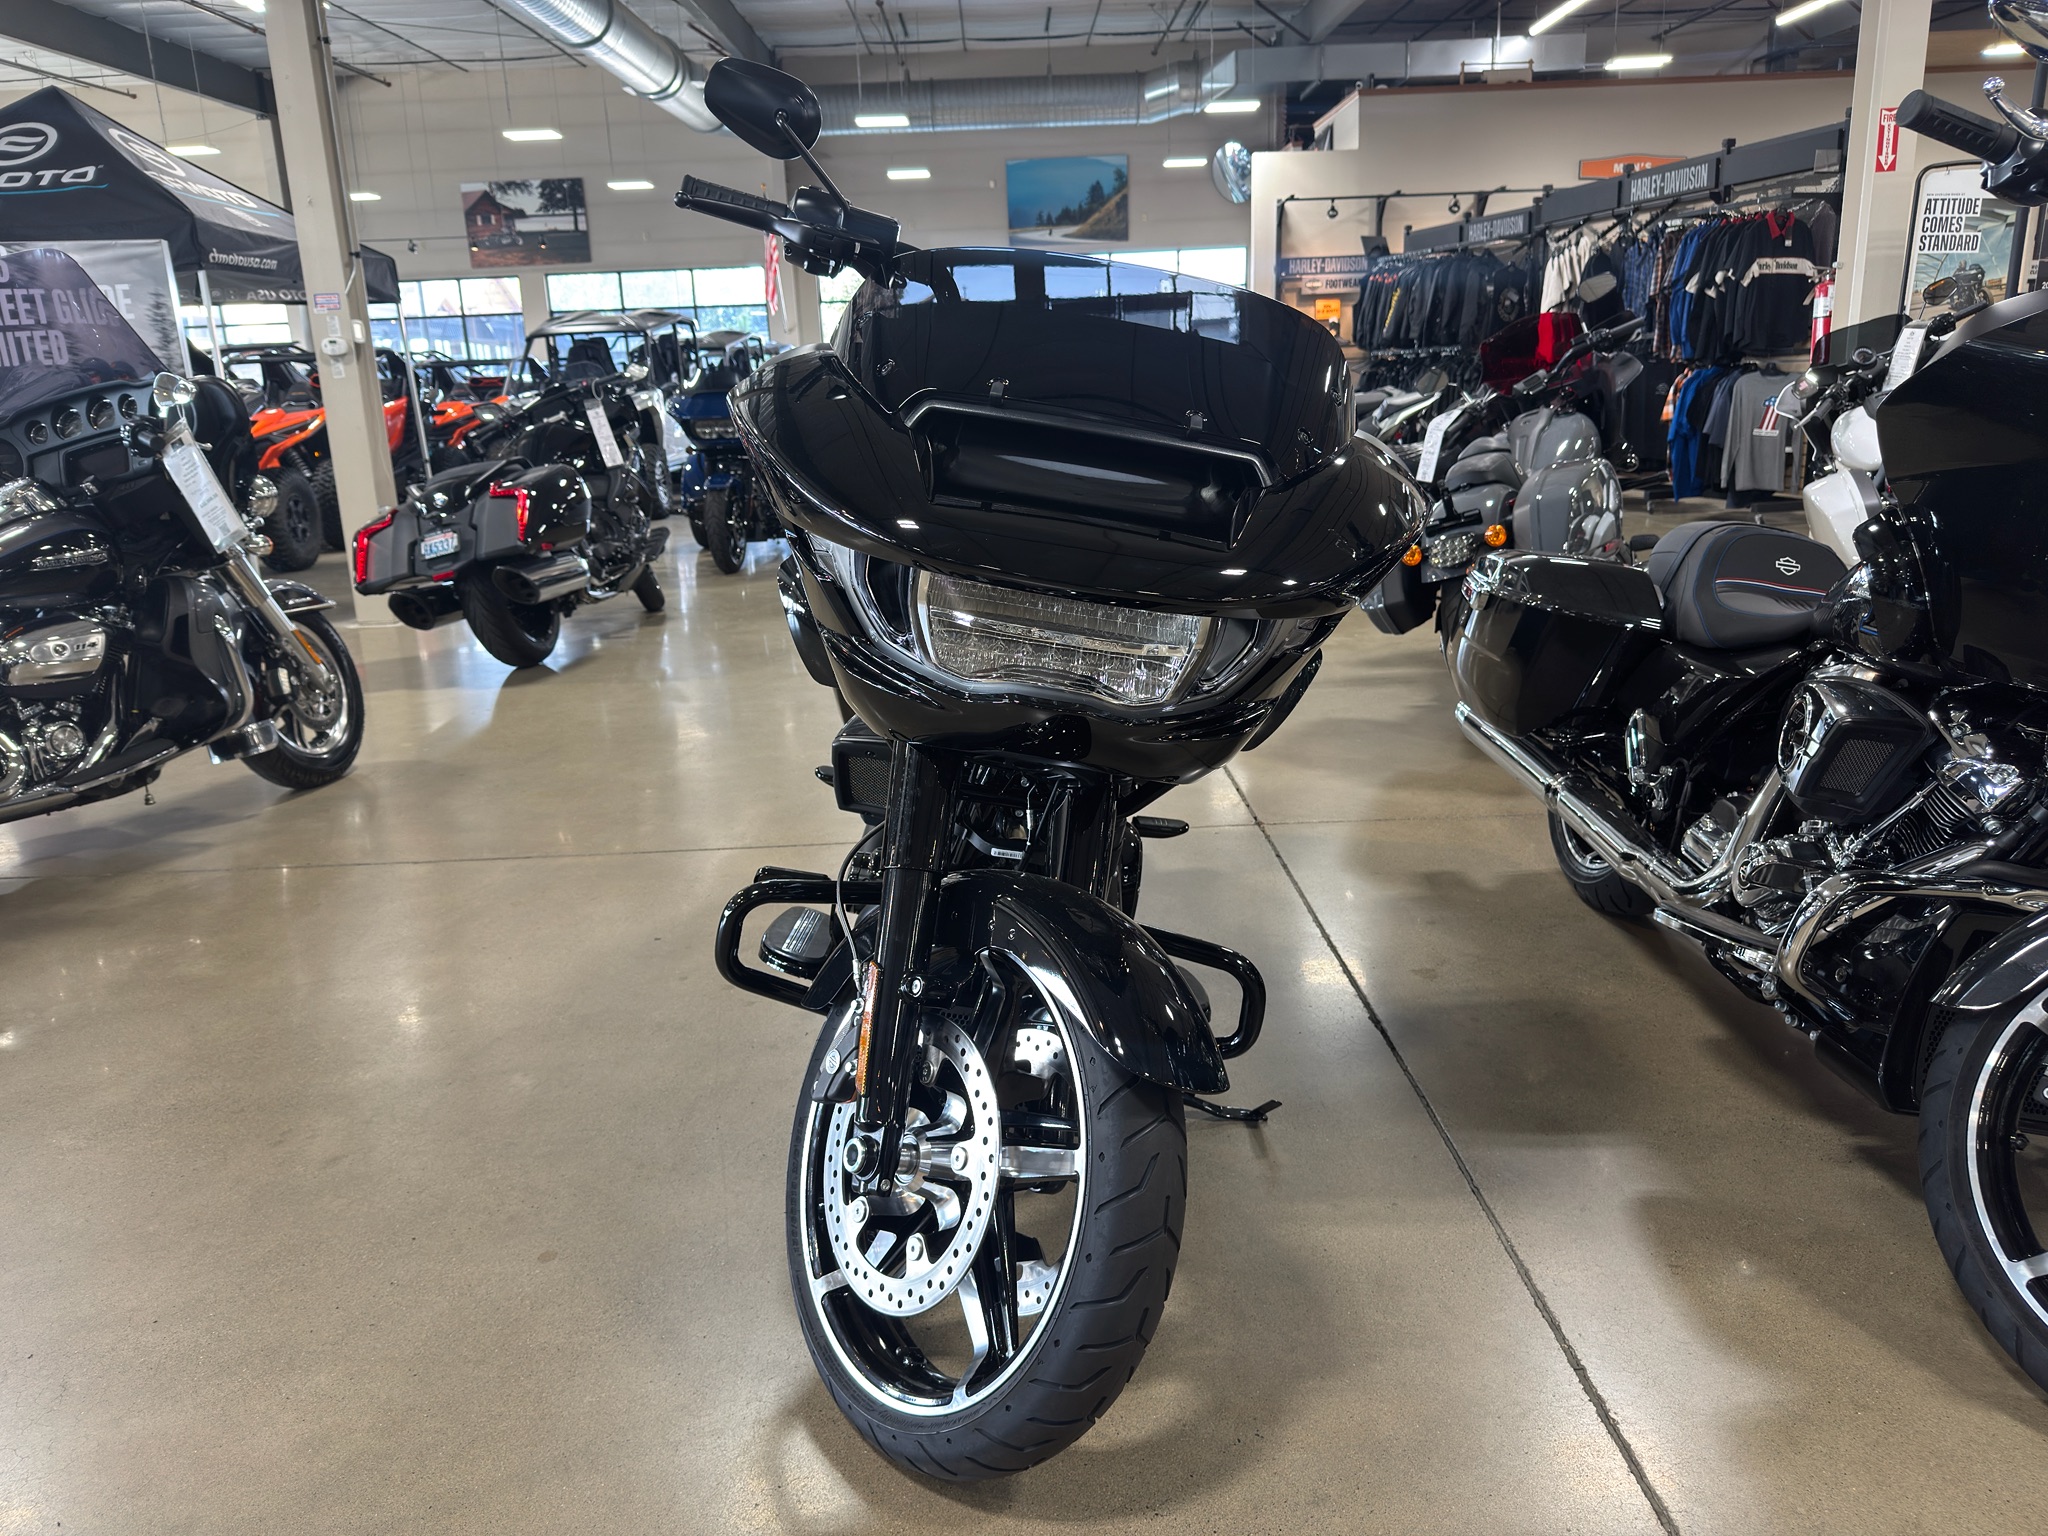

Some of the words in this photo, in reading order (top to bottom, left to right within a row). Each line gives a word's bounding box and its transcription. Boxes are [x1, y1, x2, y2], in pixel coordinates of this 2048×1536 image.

[1613, 162, 1652, 173] MN'S
[1630, 163, 1709, 202] HARLEY-DAVIDSON
[1924, 198, 1980, 215] ATTITUDE
[1469, 215, 1524, 242] HARLEY-DAVIDSON
[1921, 216, 1963, 233] COMES
[1919, 234, 1980, 251] STANDARD
[1289, 256, 1368, 273] HARLEY-DAVIDSON
[0, 288, 47, 326] EET
